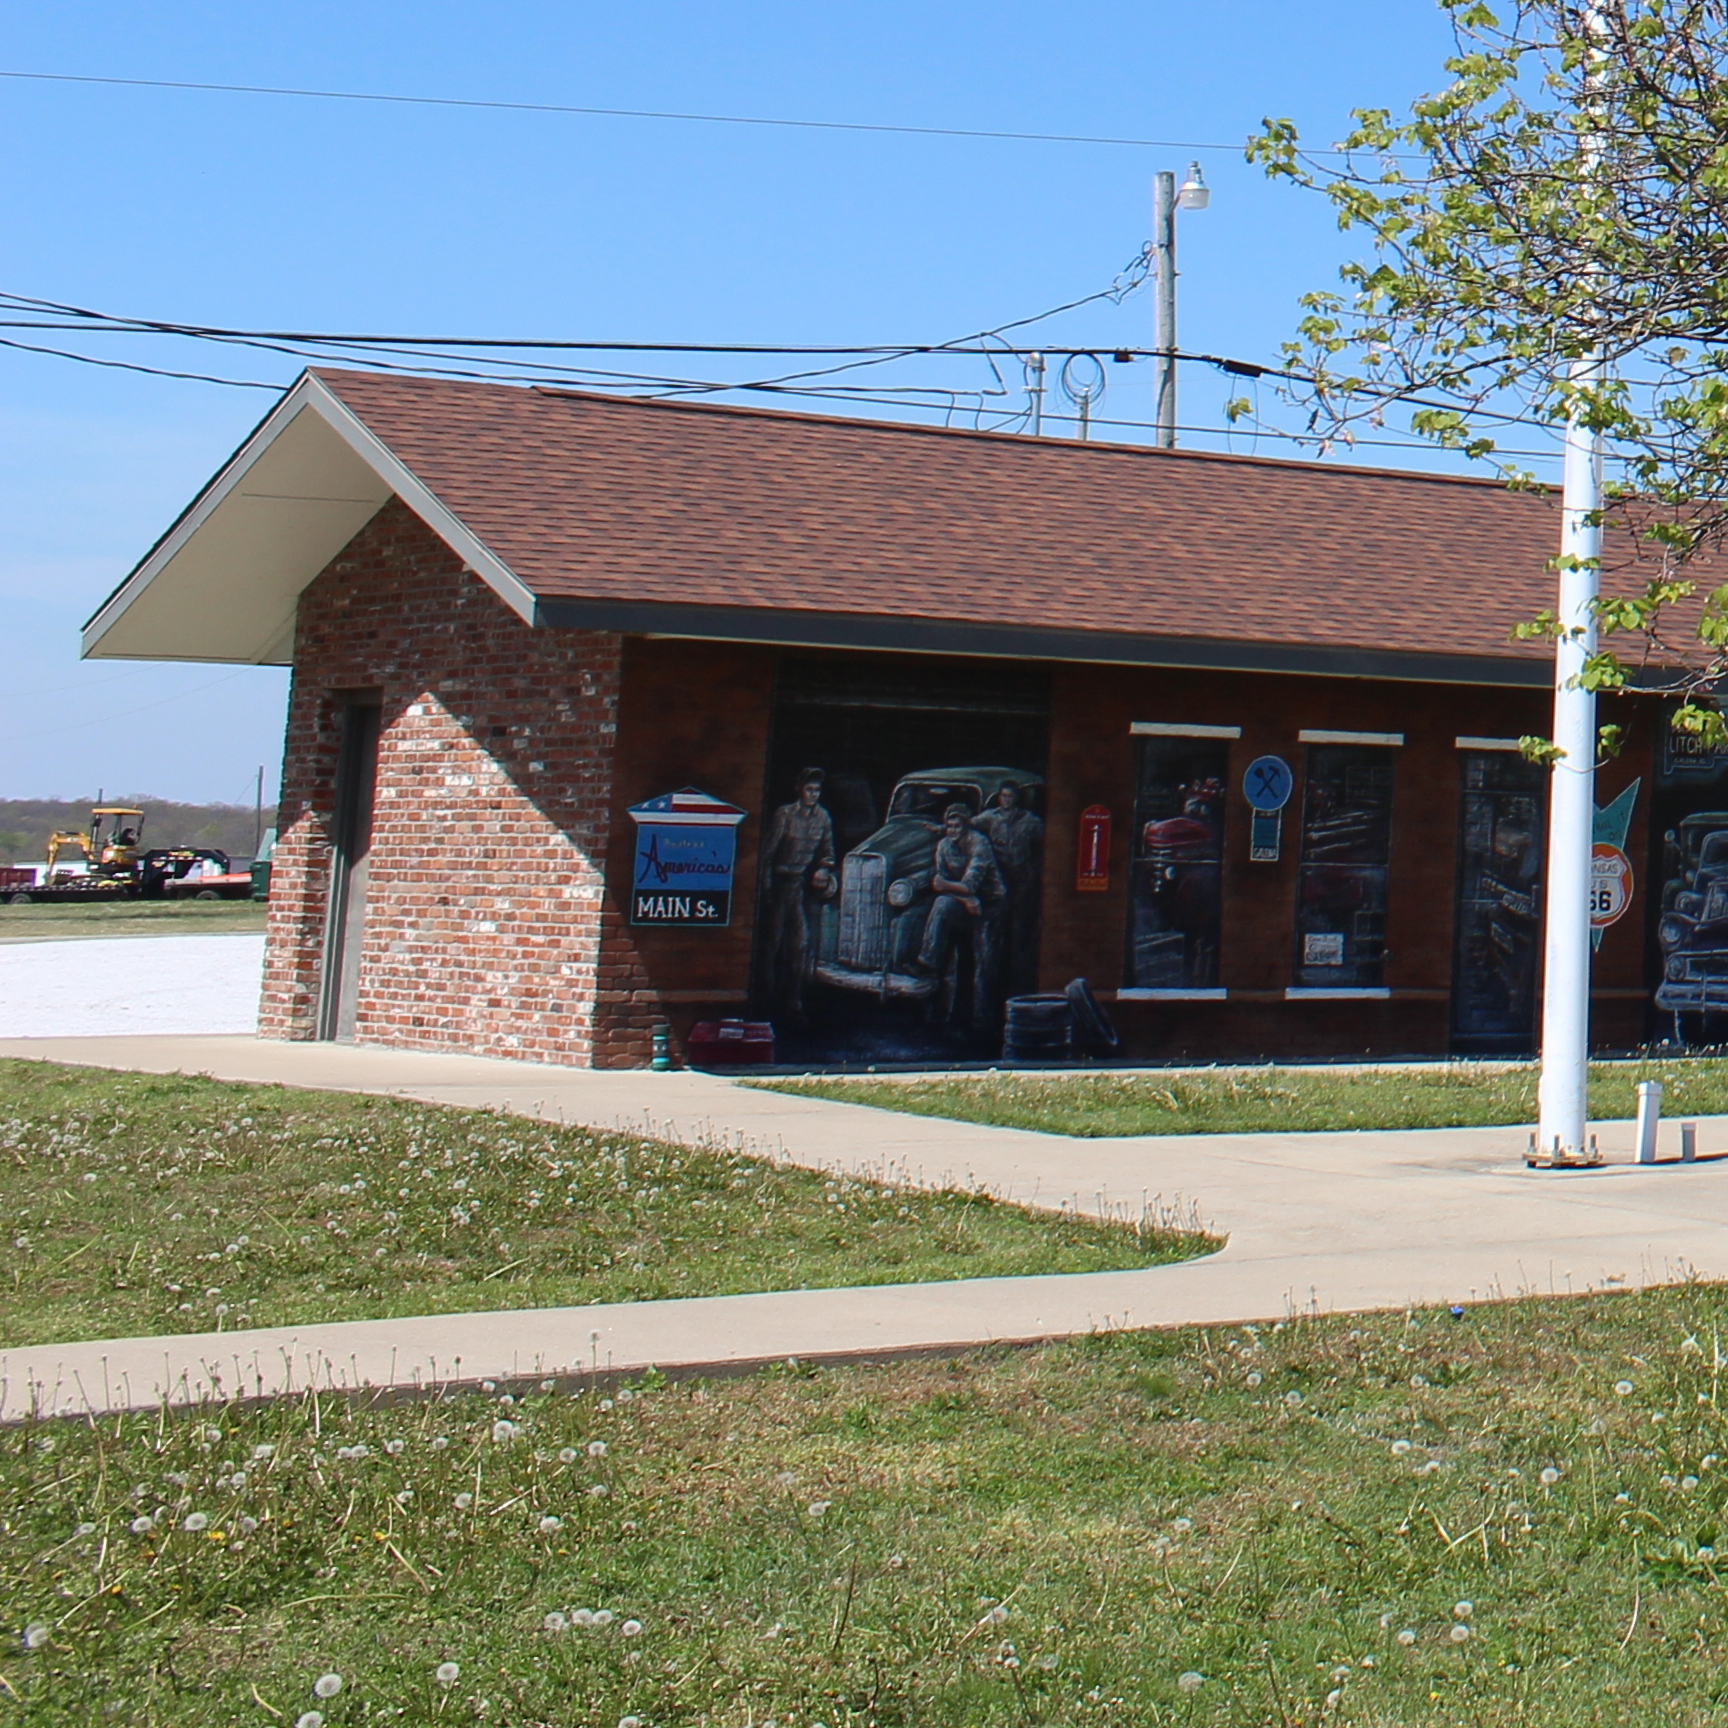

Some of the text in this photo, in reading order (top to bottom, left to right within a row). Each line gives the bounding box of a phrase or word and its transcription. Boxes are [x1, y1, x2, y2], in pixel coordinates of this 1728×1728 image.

[638, 833, 731, 884] America's
[637, 895, 719, 919] MAIN St.
